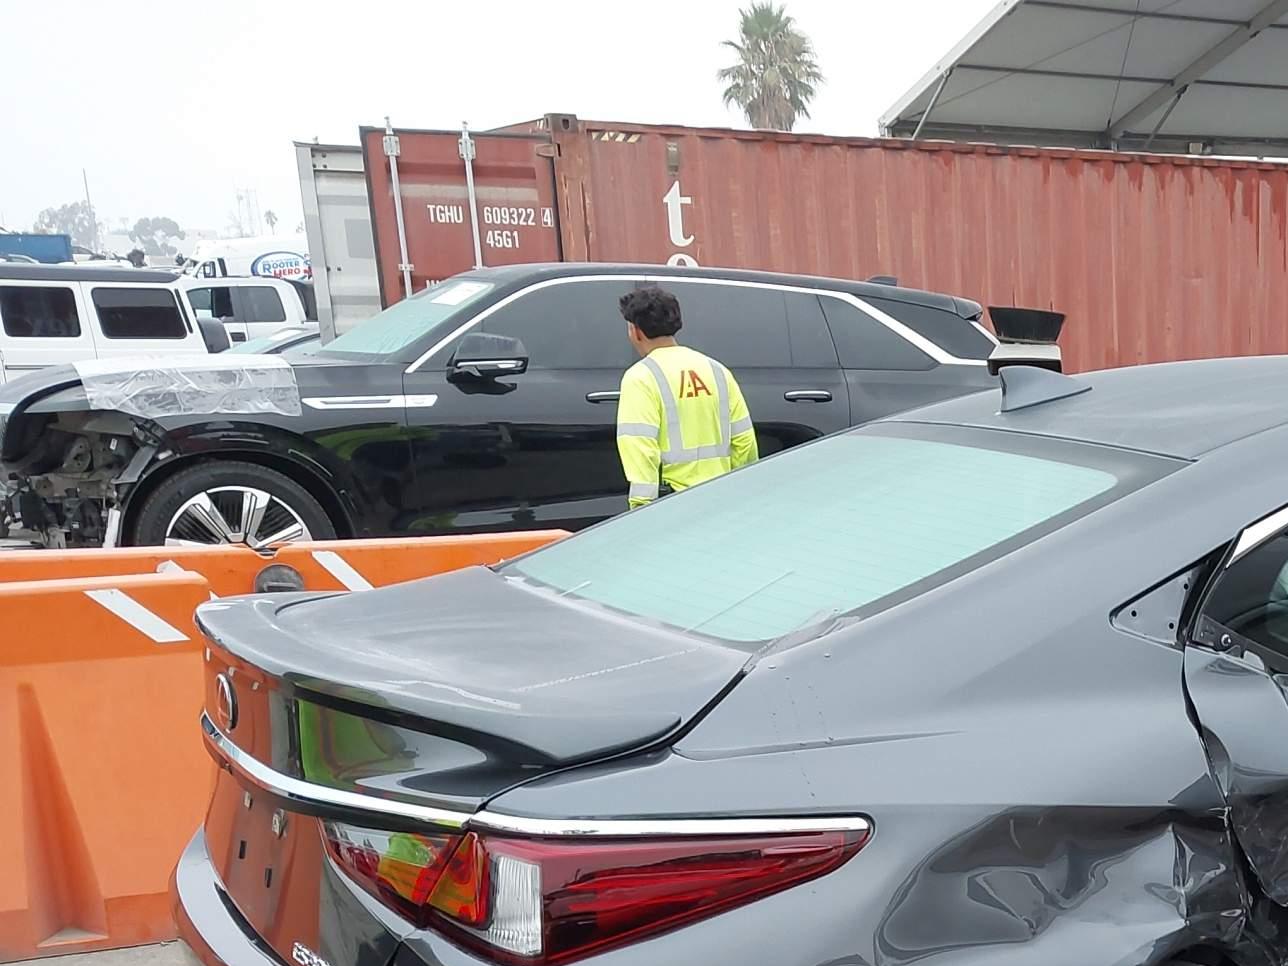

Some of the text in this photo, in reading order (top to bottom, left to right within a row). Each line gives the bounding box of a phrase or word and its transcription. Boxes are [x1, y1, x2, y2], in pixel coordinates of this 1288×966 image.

[427, 204, 553, 227] TGHU 609322 4
[486, 230, 519, 249] 45G1
[262, 260, 300, 274] ROOTER
[273, 267, 301, 278] HERO
